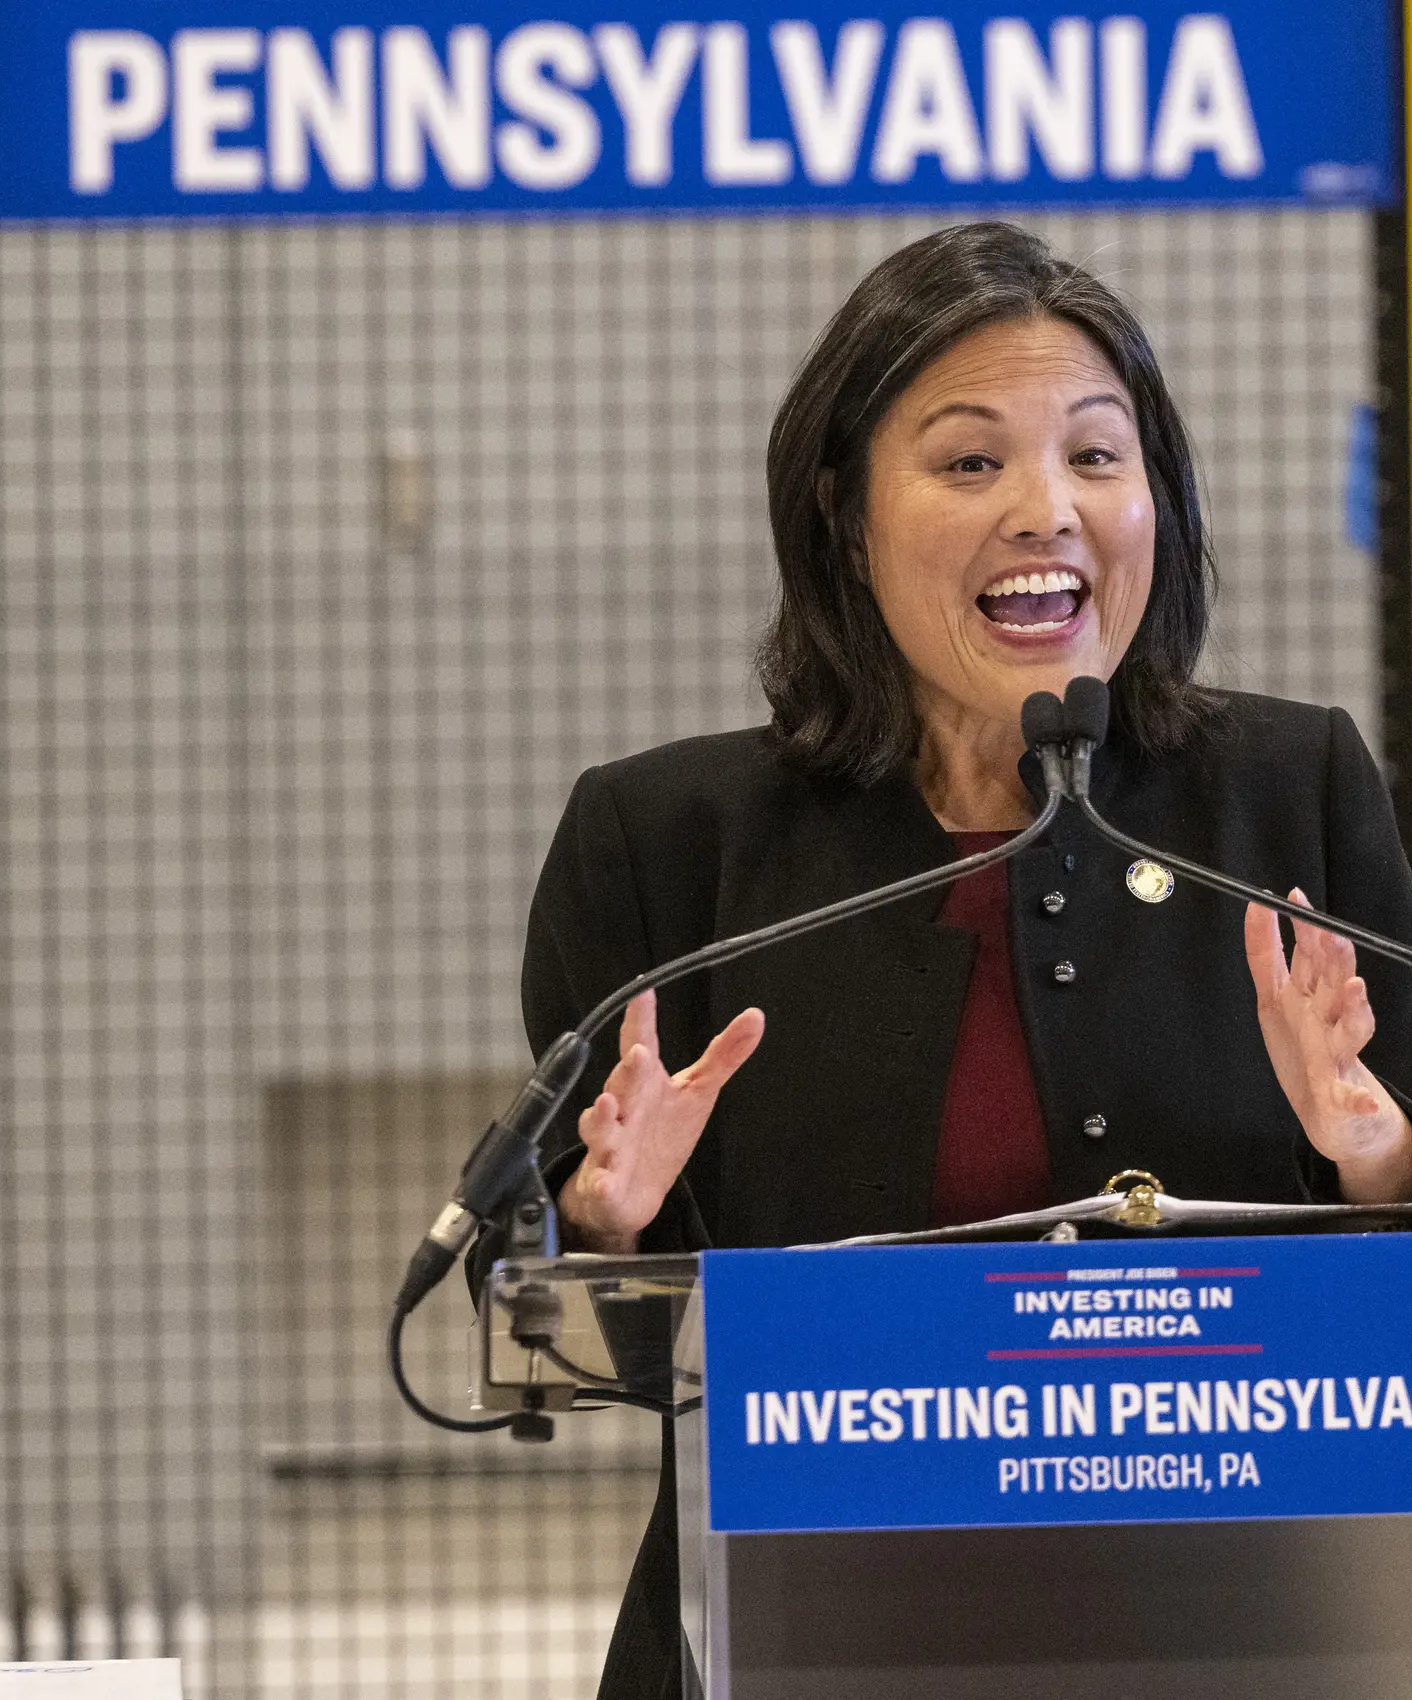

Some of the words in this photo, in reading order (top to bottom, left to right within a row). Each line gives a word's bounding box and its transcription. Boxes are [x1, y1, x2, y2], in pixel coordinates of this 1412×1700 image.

[67, 17, 1263, 193] PENNSYLVANIA
[1014, 1287, 1191, 1313] INVESTING
[1199, 1286, 1232, 1309] IN
[1049, 1314, 1201, 1340] AMERICA
[745, 1383, 1030, 1445] INVESTING
[1041, 1382, 1097, 1438] IN
[998, 1455, 1213, 1493] PITTSBURGH,
[1219, 1451, 1261, 1488] PA
